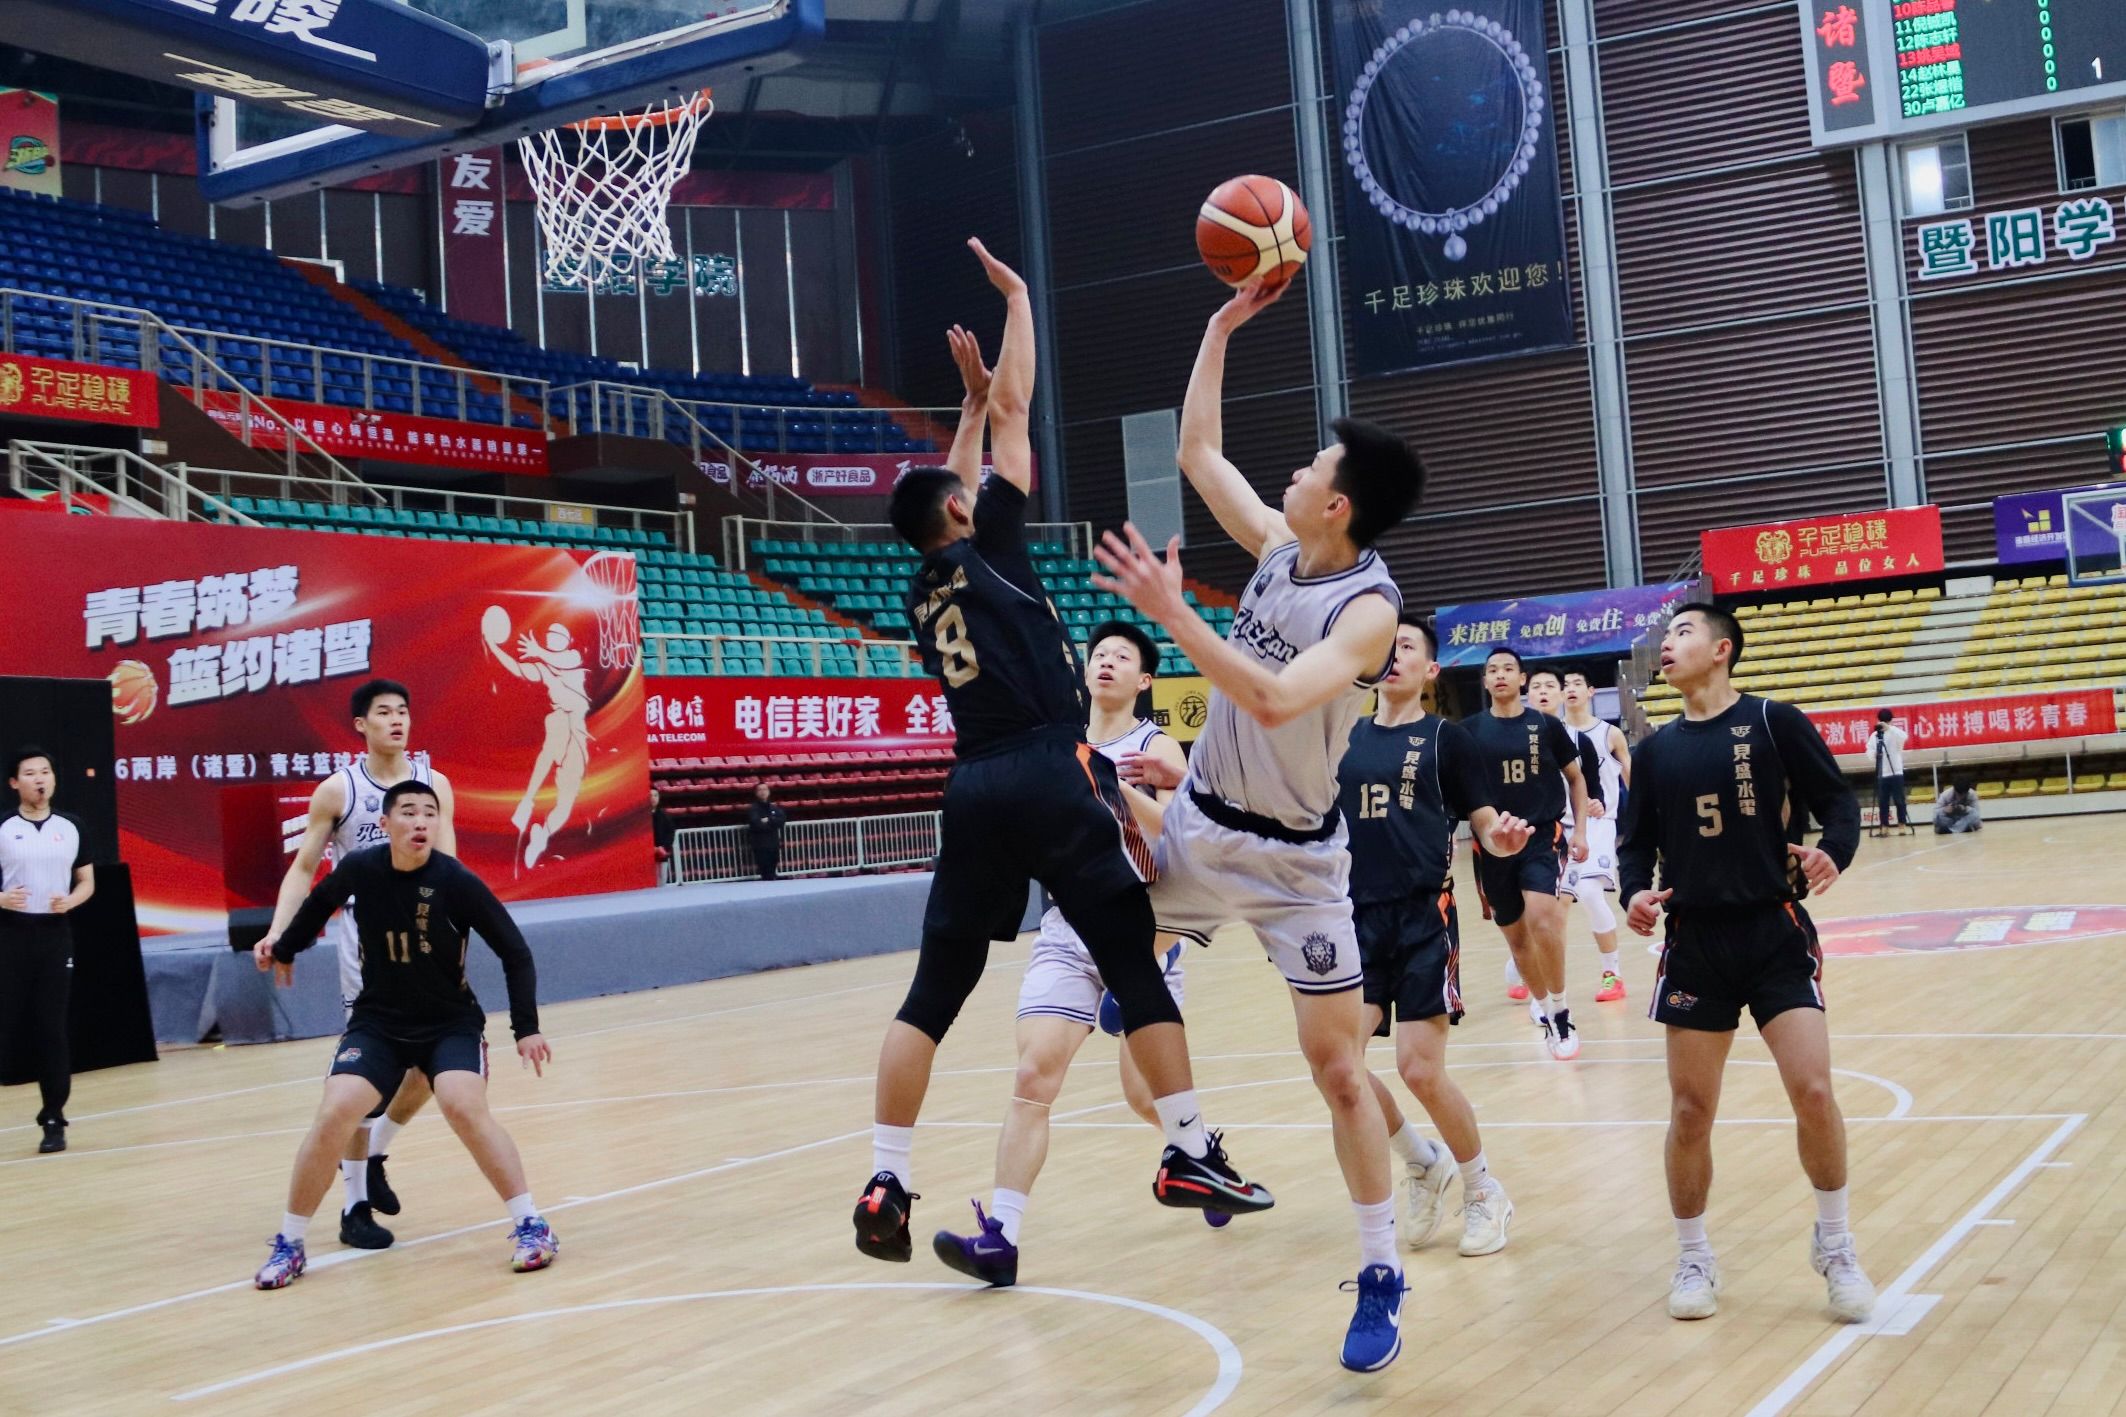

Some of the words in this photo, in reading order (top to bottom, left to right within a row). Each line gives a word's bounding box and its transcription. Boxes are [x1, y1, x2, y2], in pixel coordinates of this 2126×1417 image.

[168, 0, 377, 63] 陵
[1817, 5, 1866, 106] 诸暨
[2091, 57, 2102, 79] 1
[451, 154, 495, 236] 友爱
[31, 367, 131, 402] 千足珍珠
[32, 394, 77, 409] PURE
[78, 399, 132, 415] PEARL
[812, 469, 871, 483] 浙产好食品
[1798, 519, 1888, 547] 千足珍珠
[1800, 547, 1838, 558] PURE
[1840, 540, 1888, 553] PEARL
[1730, 565, 1812, 586] 千足珍珠
[1835, 552, 1920, 576] 品位女人
[83, 565, 299, 650] 青春筑梦
[1448, 618, 1512, 646] 来诸暨
[1520, 612, 1567, 638] 免费创
[1576, 607, 1623, 633] 免费住
[166, 618, 371, 706] 篮约诸暨
[934, 603, 981, 689] 8
[735, 695, 881, 739] 电信美好家
[904, 694, 956, 735] 全家
[1816, 719, 1871, 748] 激情
[660, 733, 706, 742] TELECOM
[1399, 750, 1422, 811] 見盛水電
[1502, 759, 1526, 785] 18
[1733, 743, 1757, 816] 見盛水電
[1358, 783, 1391, 820] 12
[1695, 793, 1724, 838] 5
[385, 930, 411, 963] 11
